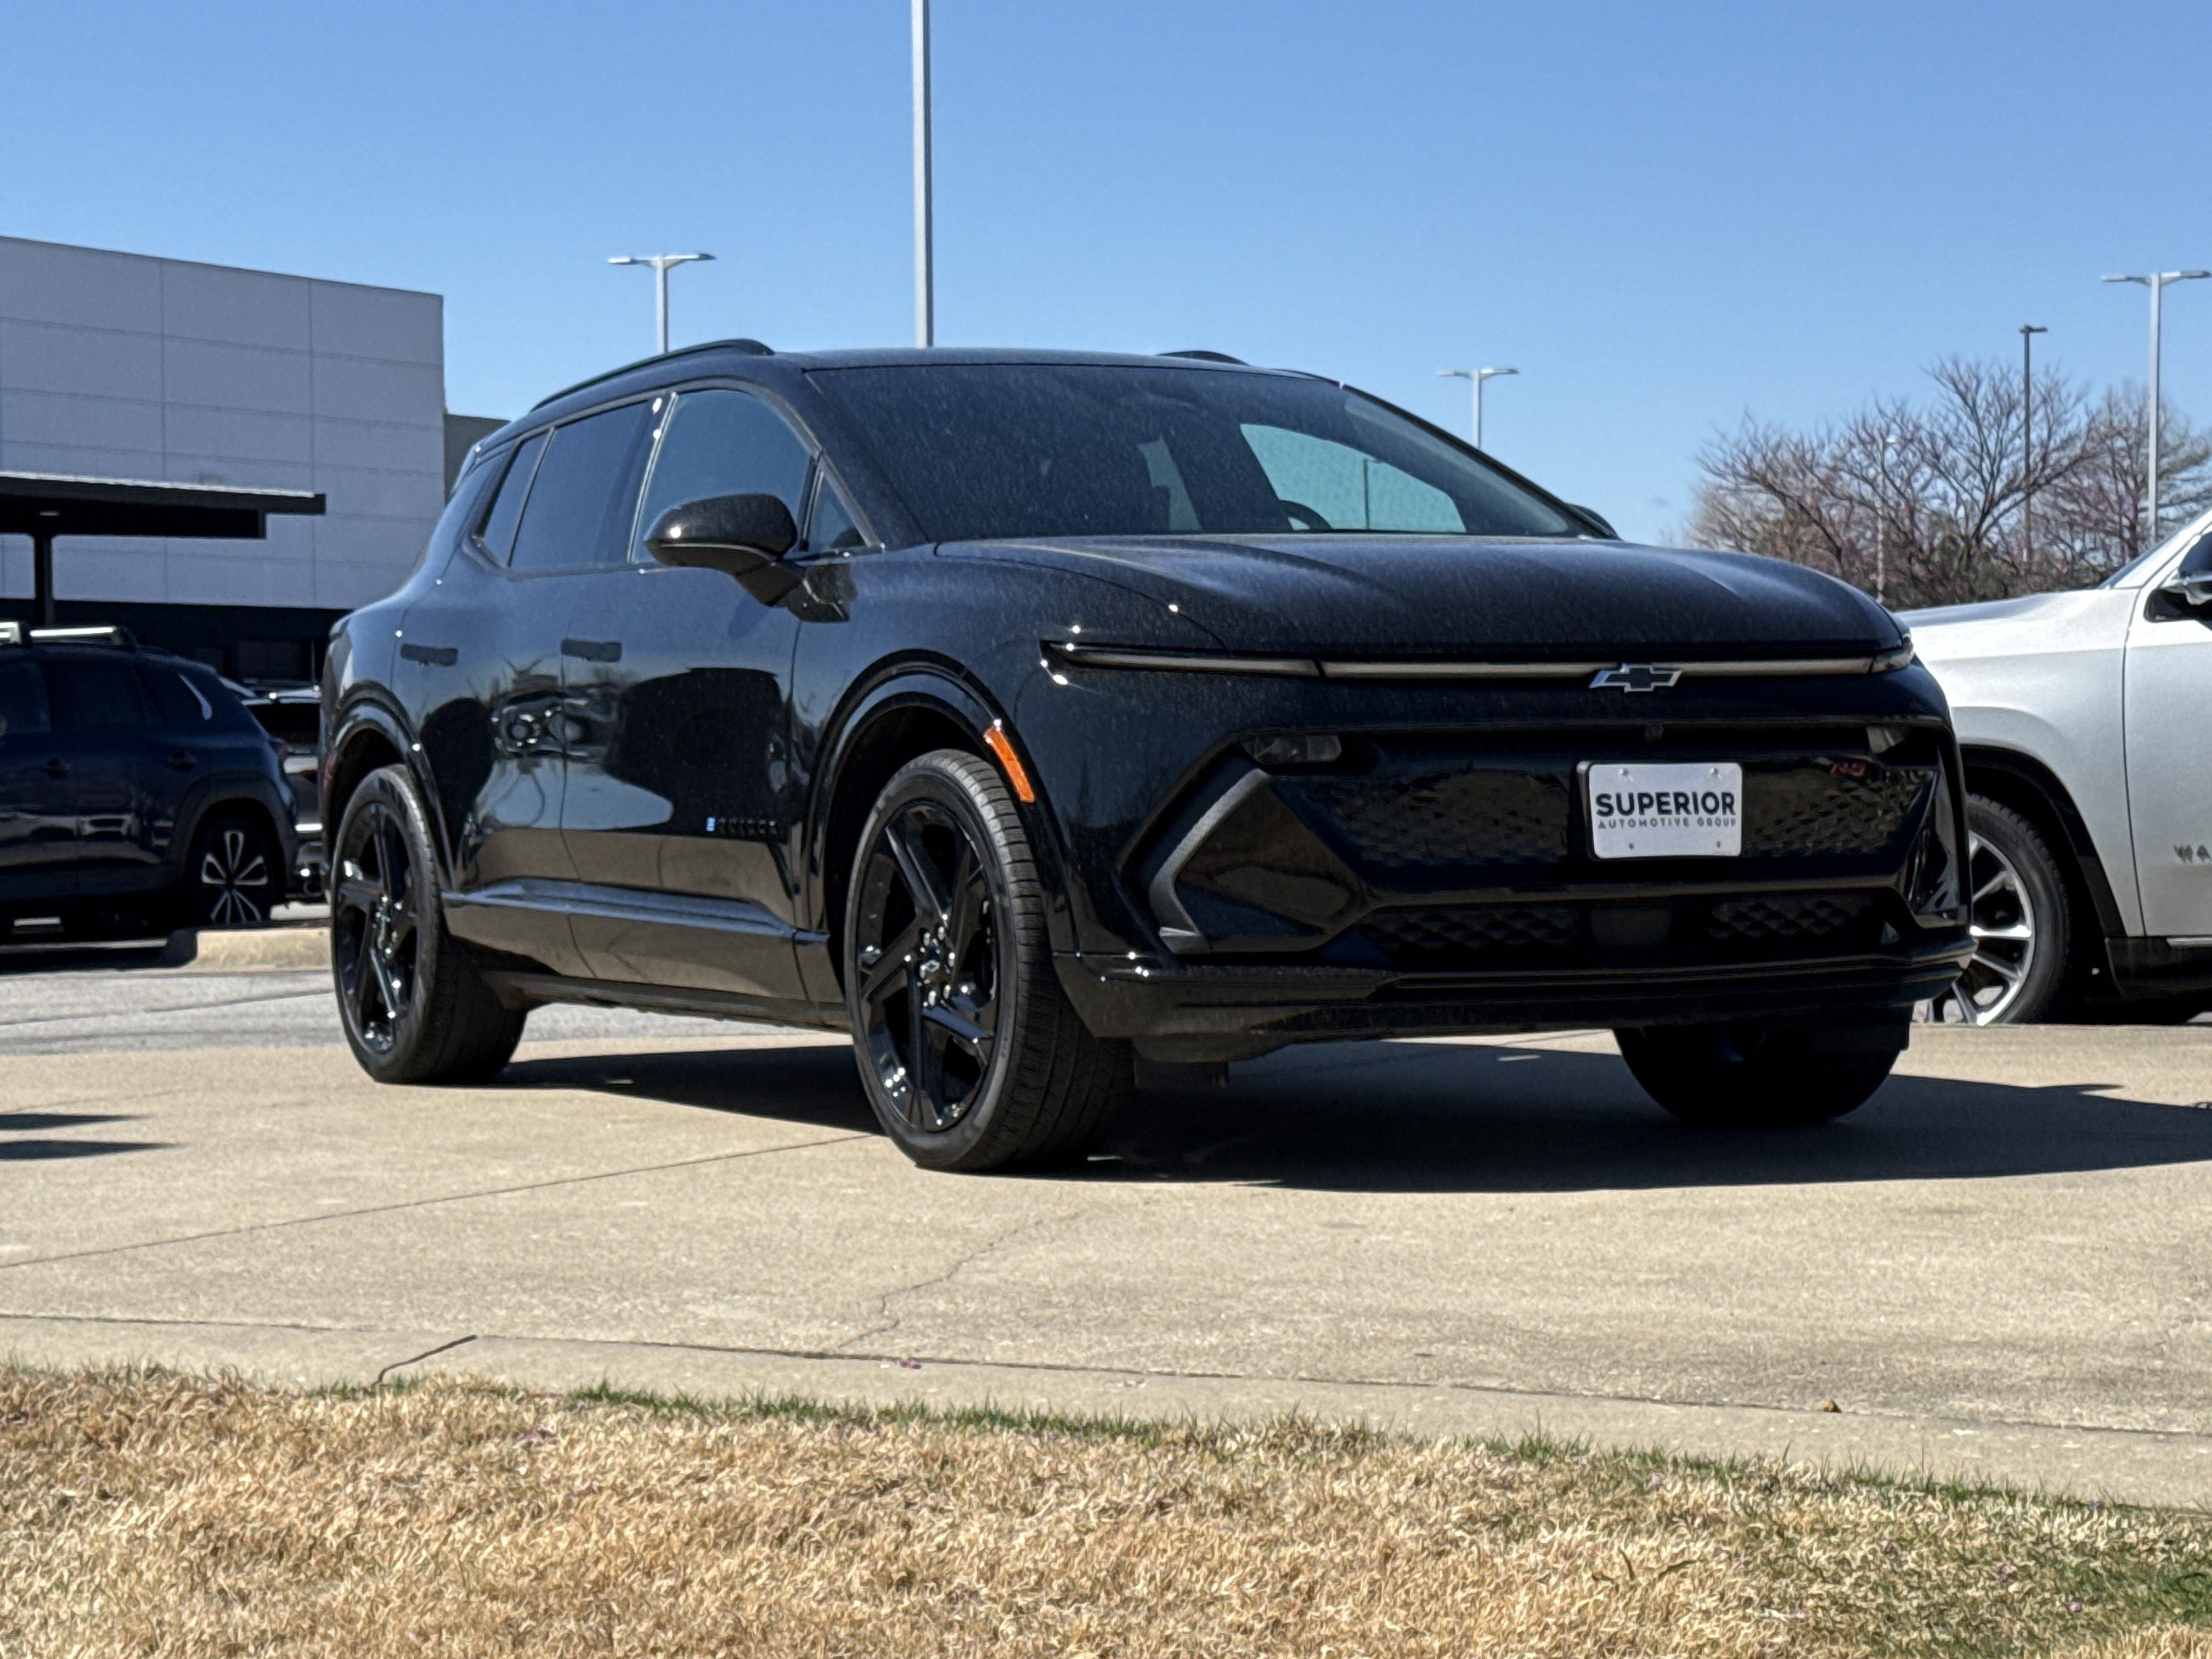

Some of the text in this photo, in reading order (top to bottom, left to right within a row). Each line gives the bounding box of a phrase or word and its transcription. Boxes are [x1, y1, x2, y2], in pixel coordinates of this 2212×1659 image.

[1595, 791, 1736, 817] SUPERIOR
[1598, 817, 1736, 830] AUTOMOTIVE GROUP
[2172, 843, 2212, 864] WA
